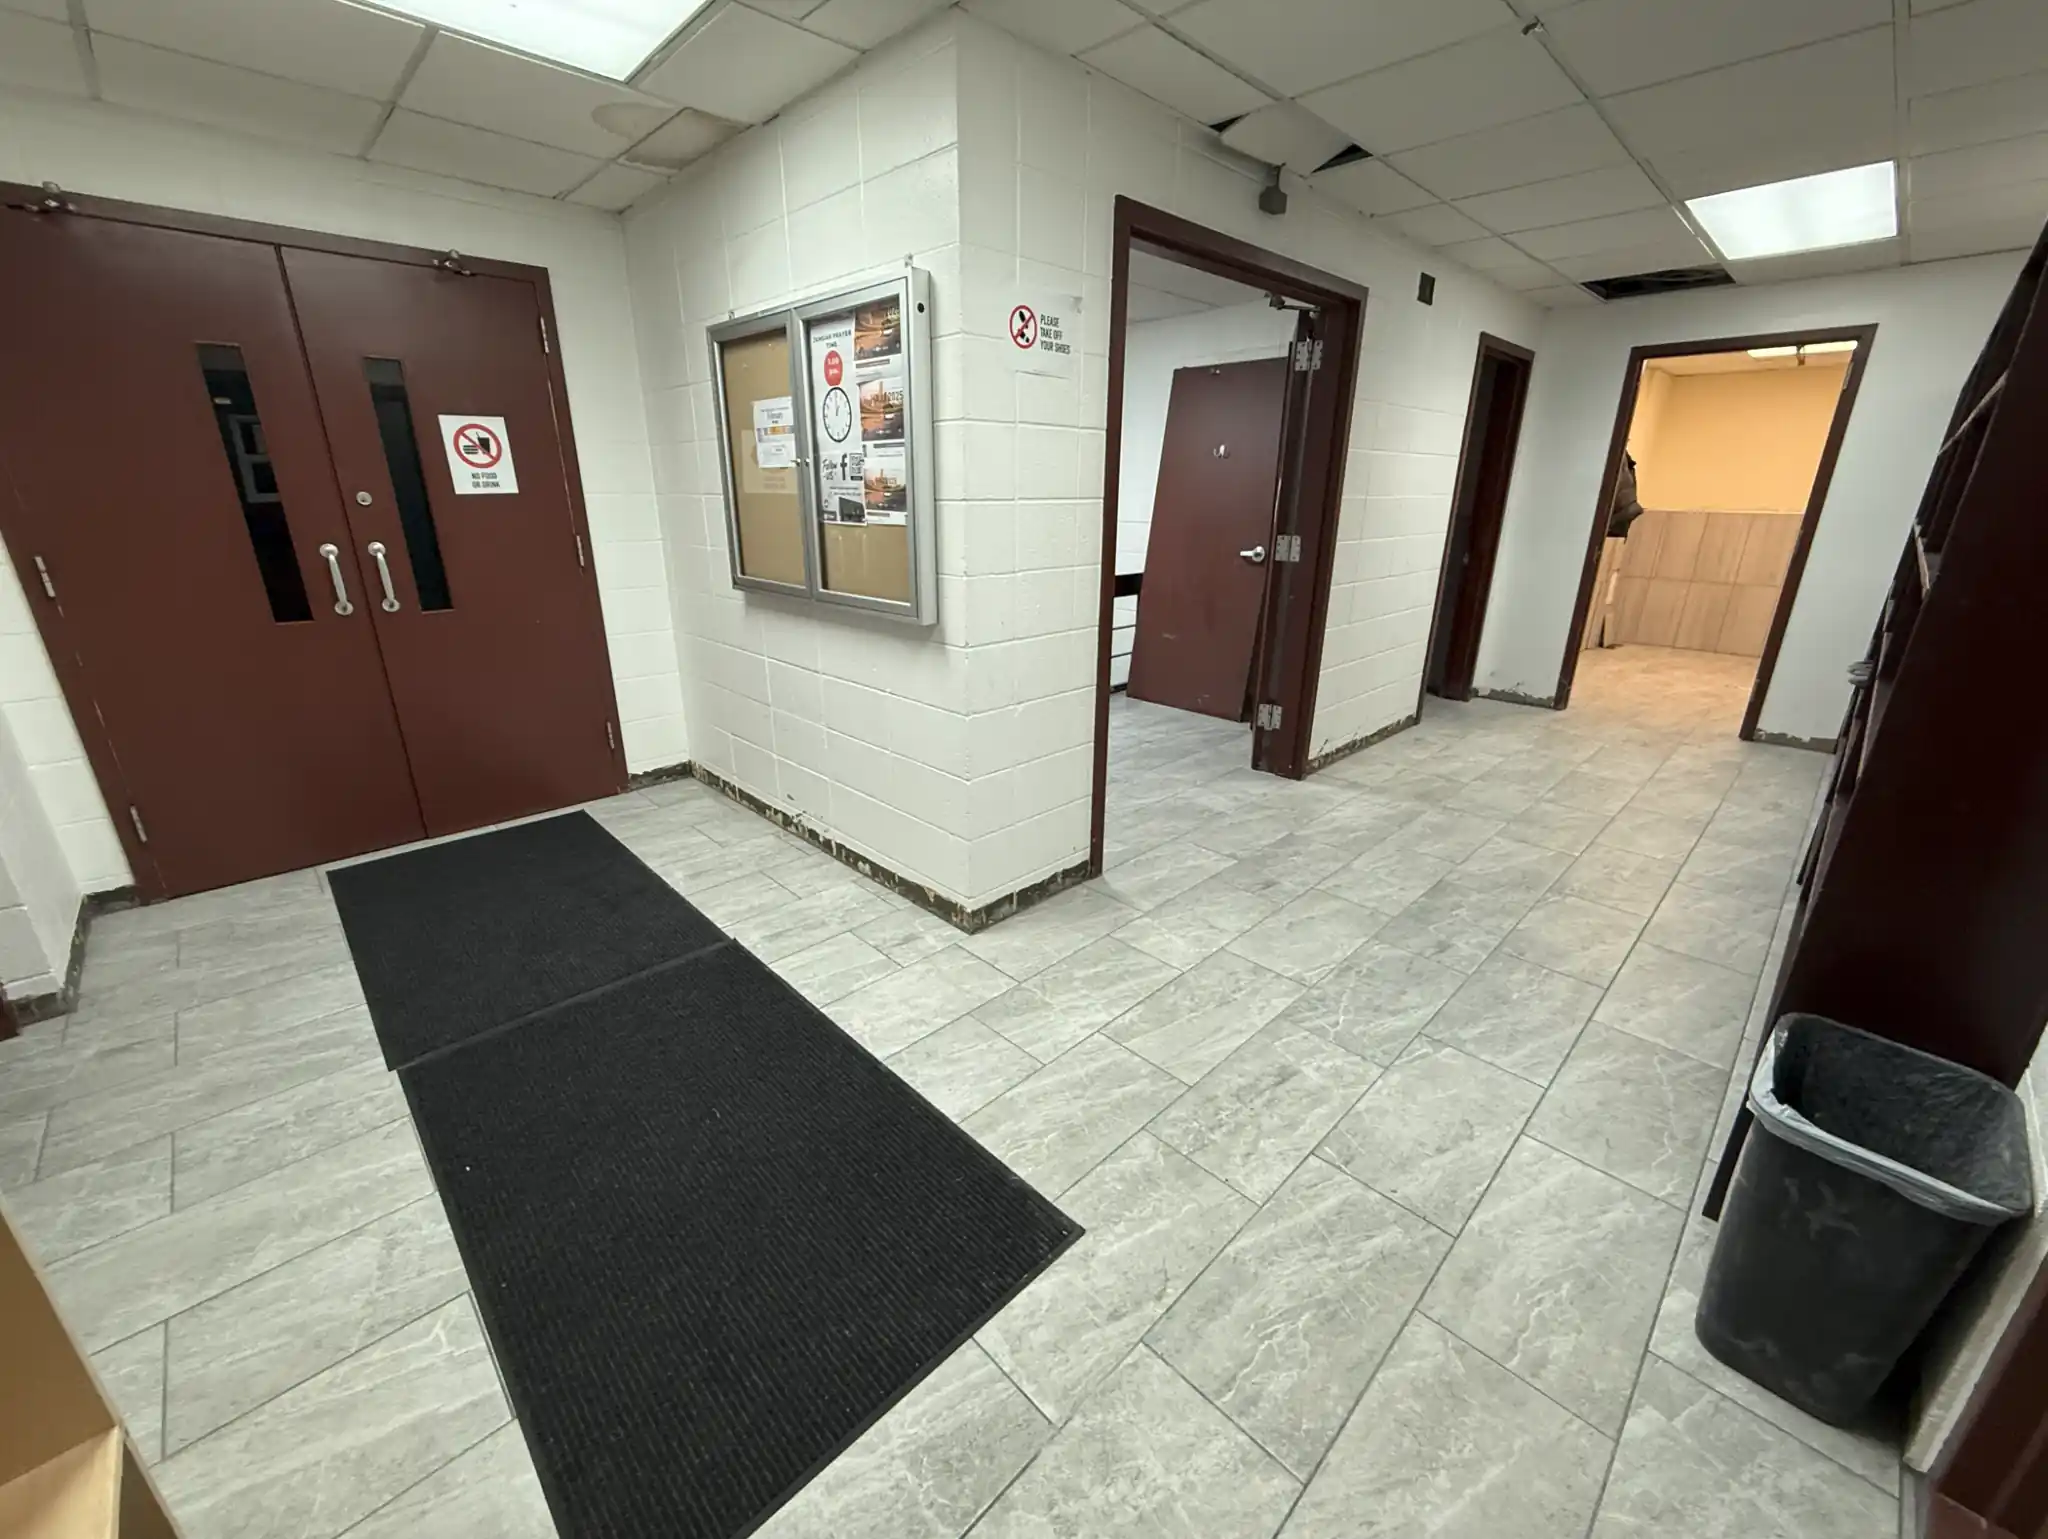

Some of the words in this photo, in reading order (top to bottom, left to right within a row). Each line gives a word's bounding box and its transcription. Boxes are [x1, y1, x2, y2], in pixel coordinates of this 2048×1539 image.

[1040, 313, 1060, 328] PLEASE
[832, 329, 852, 338] PRAYER
[1040, 327, 1053, 339] TAKE
[1053, 329, 1063, 340] OFF
[1040, 340, 1054, 351] YOUR
[1054, 342, 1071, 355] SHOES
[471, 472, 481, 480] NO
[481, 472, 498, 480] FOOD
[472, 481, 481, 489] OR
[482, 481, 501, 489] DRINK
